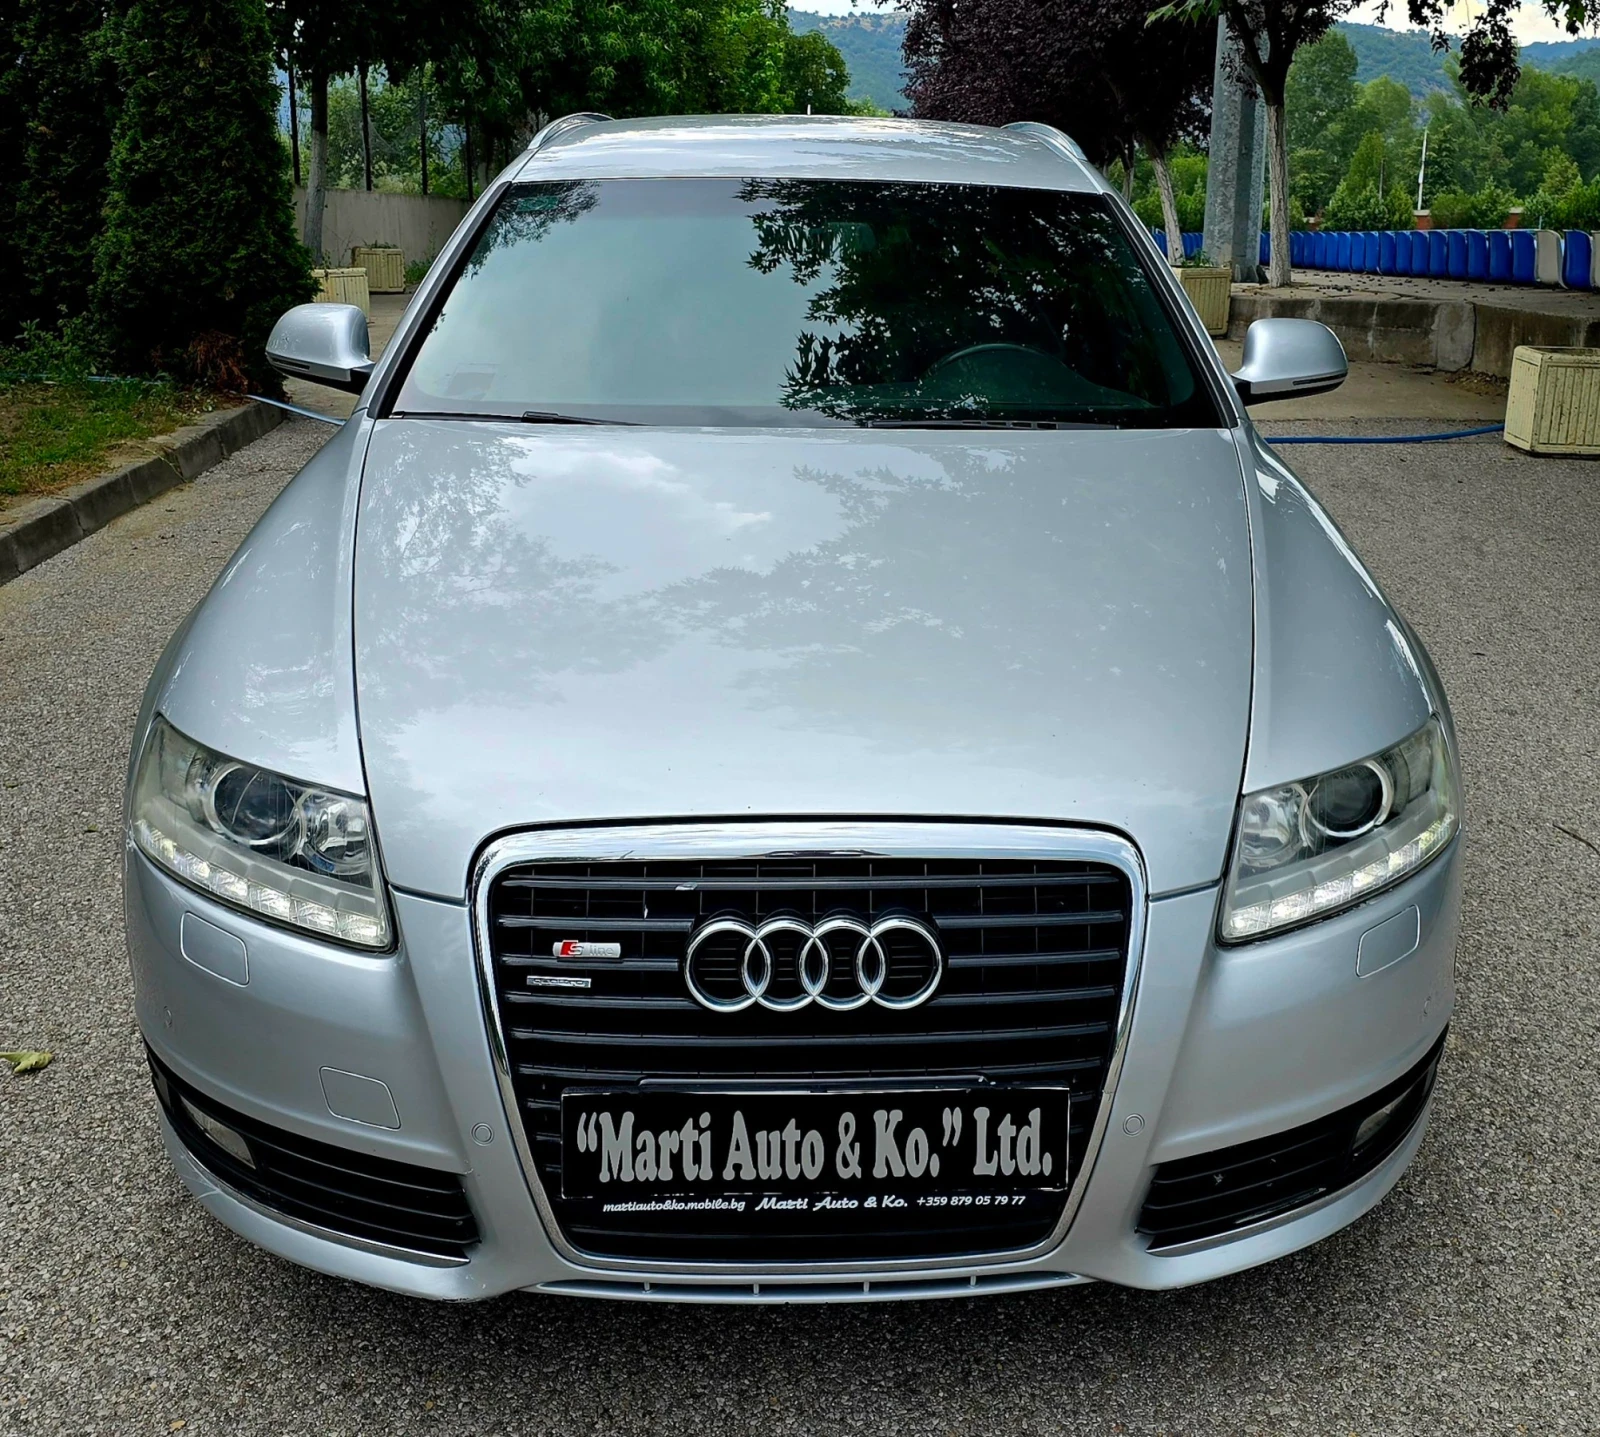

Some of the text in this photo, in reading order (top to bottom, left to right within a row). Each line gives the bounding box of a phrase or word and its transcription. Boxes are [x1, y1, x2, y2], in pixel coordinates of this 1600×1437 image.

[722, 1110, 825, 1181] Auto
[836, 1111, 862, 1179] &
[973, 1106, 1053, 1176] Ltd.
[603, 1195, 1026, 1212] martiauto&ko.mobile.bg Marti Auto & Ko. +359 879 05 79 77
